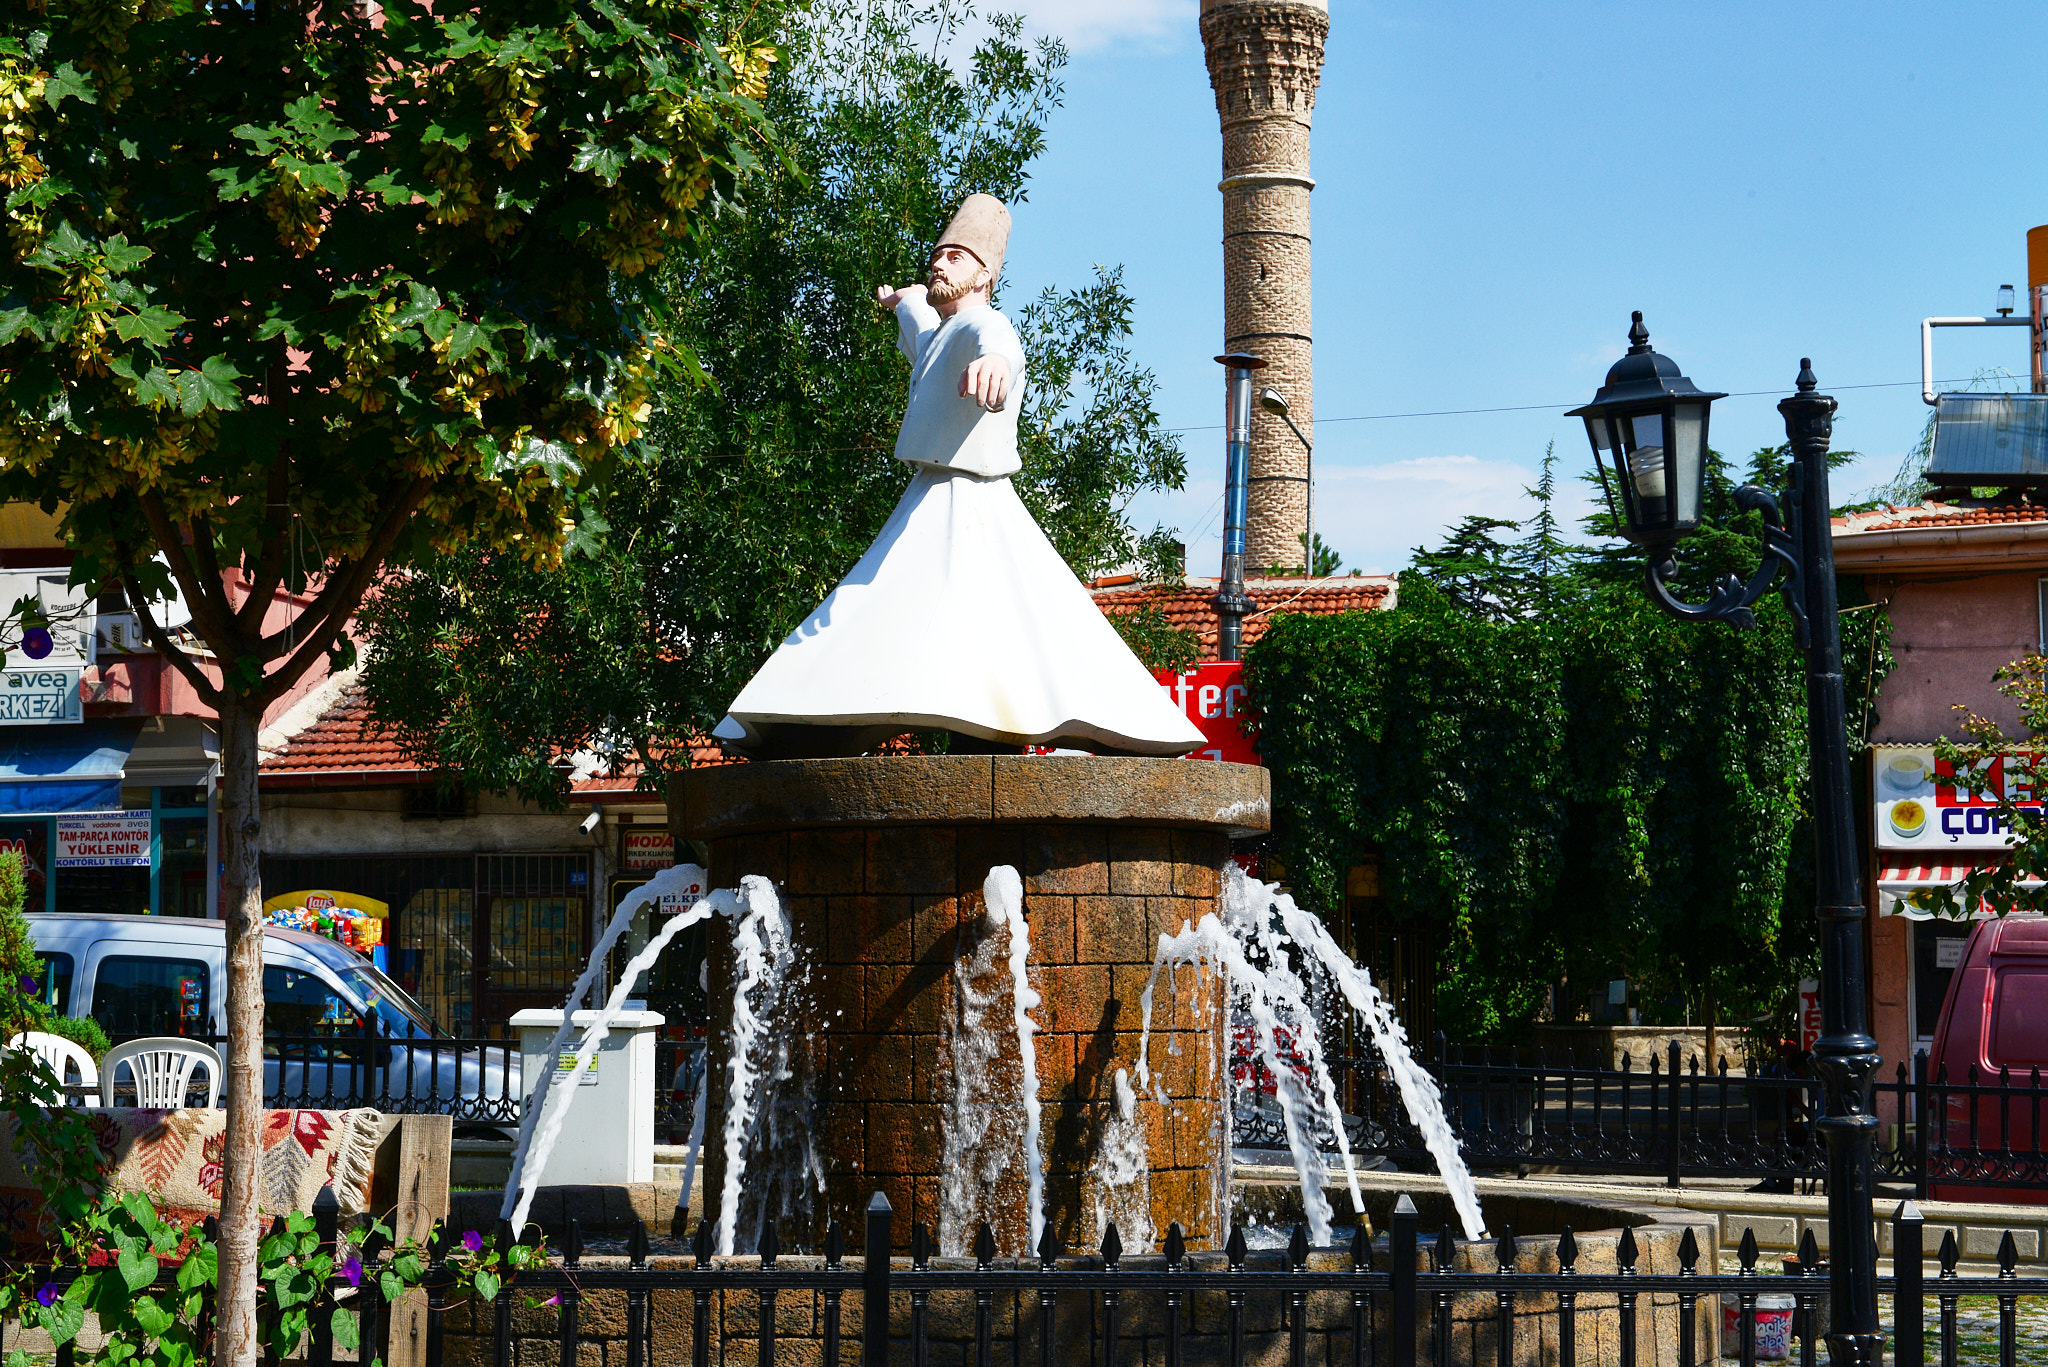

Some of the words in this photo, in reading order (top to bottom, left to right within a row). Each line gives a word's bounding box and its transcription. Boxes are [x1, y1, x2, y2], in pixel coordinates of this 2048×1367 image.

[8, 672, 68, 688] avea
[1161, 669, 1249, 719] fer
[130, 810, 151, 818] KARTI
[59, 831, 109, 844] TAM-PARÇA
[111, 828, 149, 841] KONTÖR
[627, 835, 674, 848] MODA
[68, 842, 140, 855] YÜKLENİR
[108, 857, 150, 866] TELEFON
